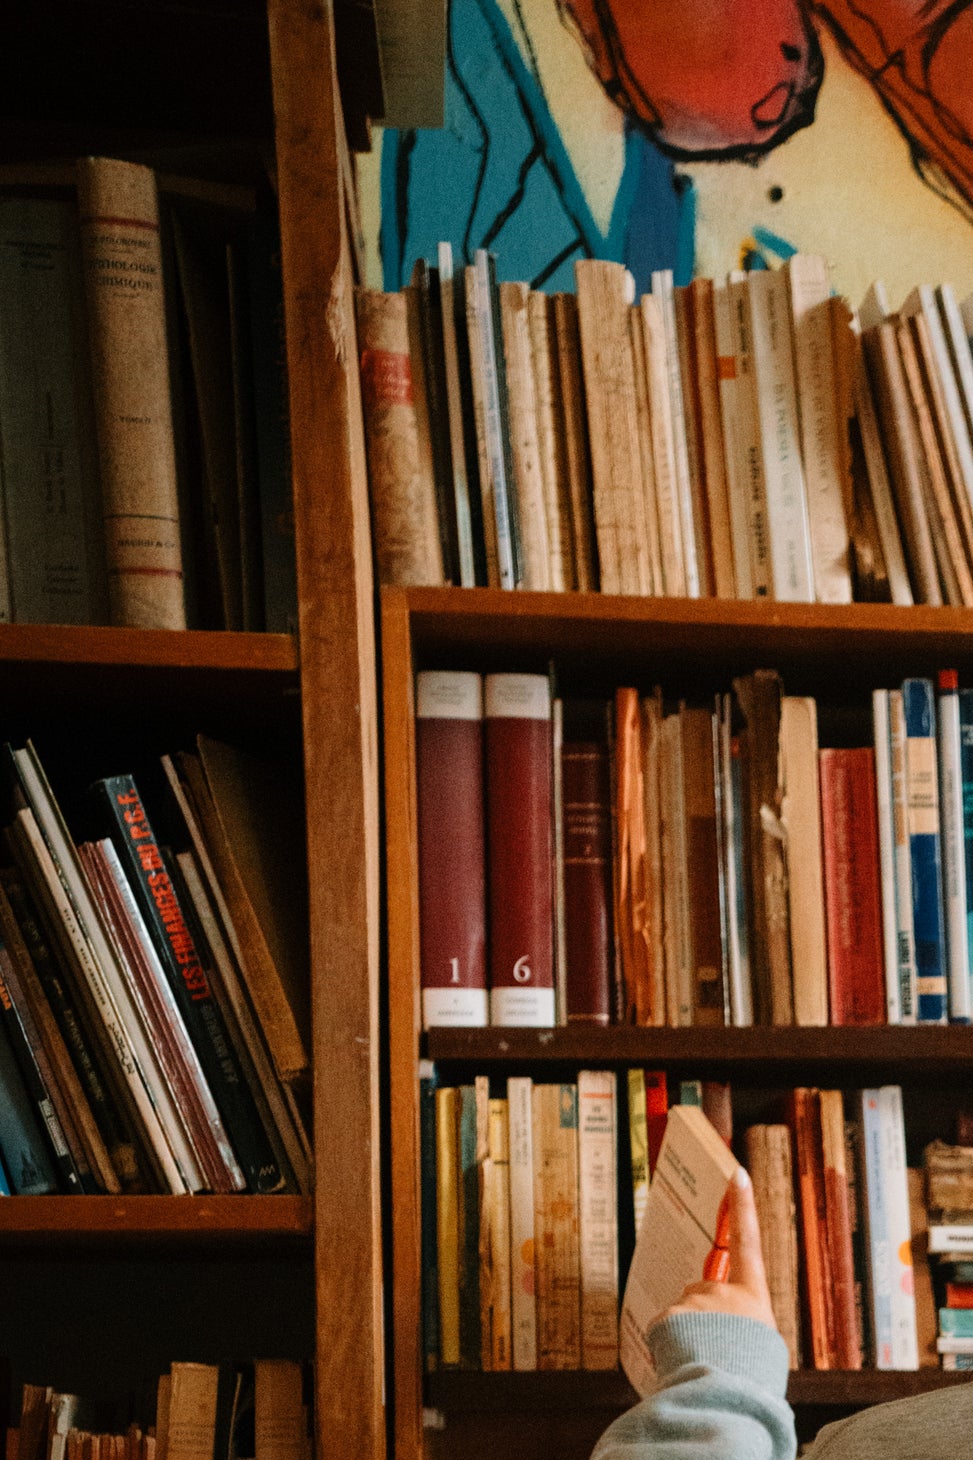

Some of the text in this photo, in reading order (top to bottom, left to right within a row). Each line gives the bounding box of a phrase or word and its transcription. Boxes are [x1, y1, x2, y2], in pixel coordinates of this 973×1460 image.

[147, 872, 197, 965] FINANCES
[180, 964, 211, 1000] LES
[448, 957, 462, 984] 1
[512, 954, 532, 984] 6
